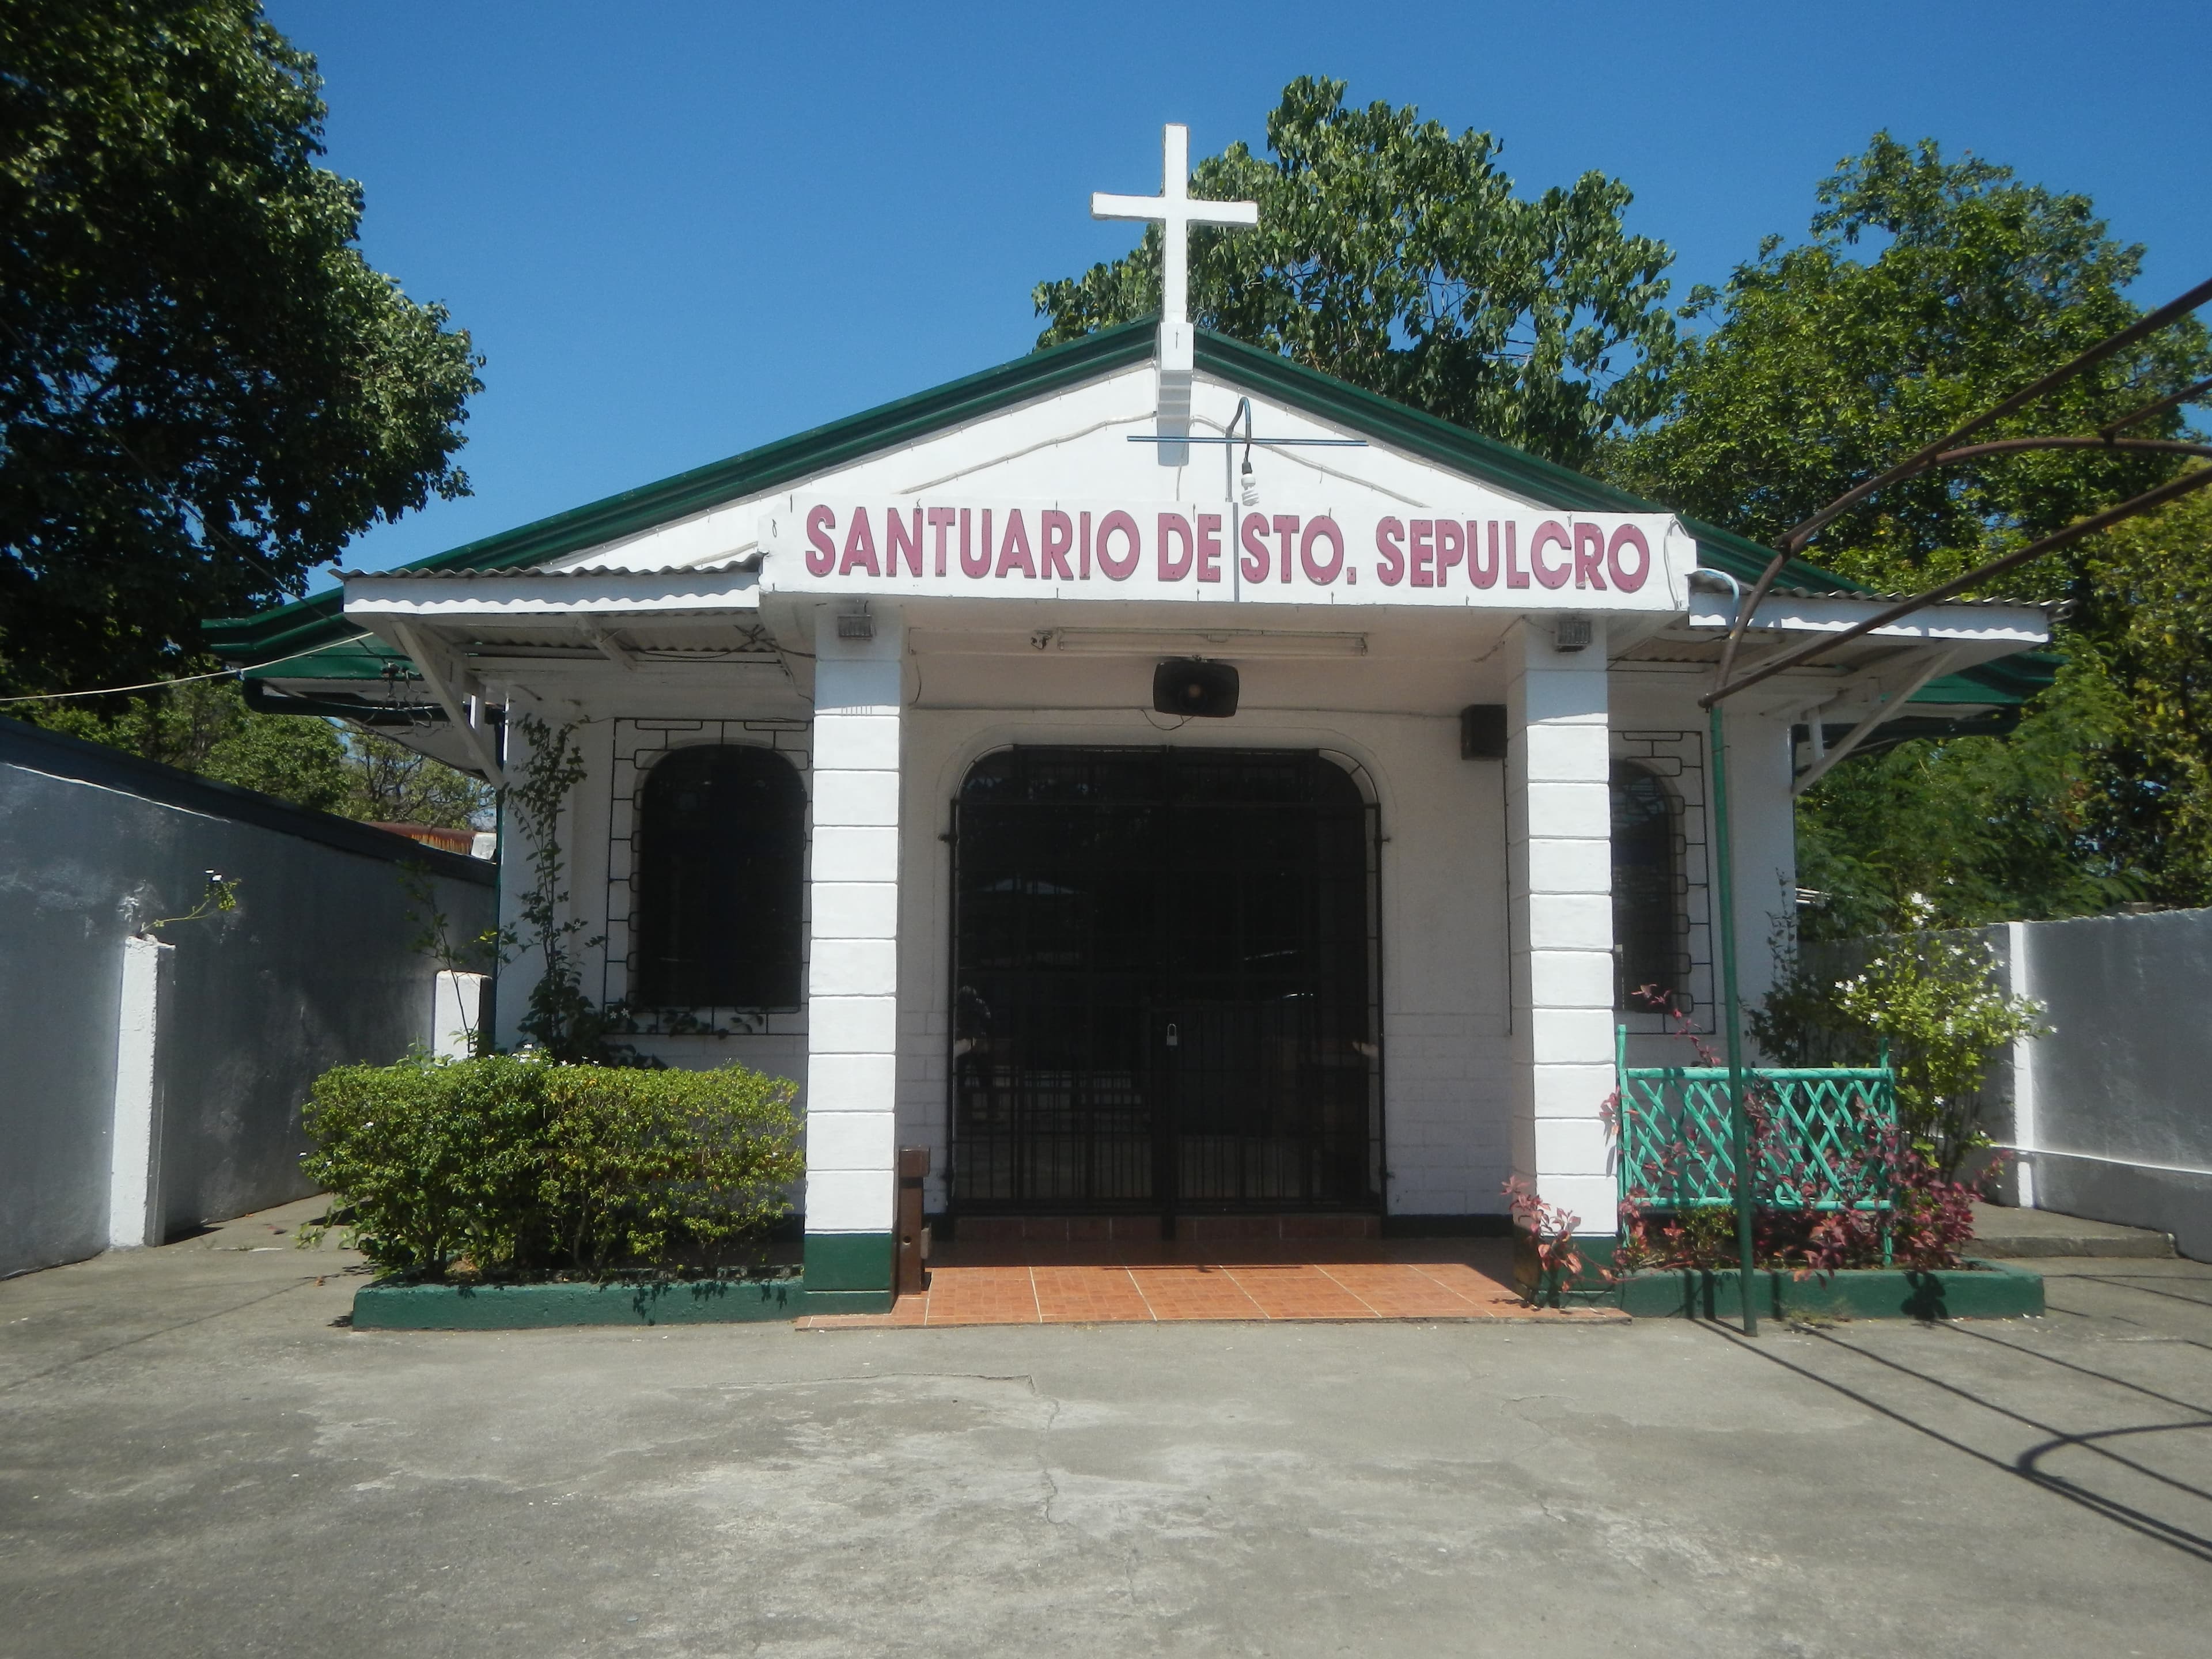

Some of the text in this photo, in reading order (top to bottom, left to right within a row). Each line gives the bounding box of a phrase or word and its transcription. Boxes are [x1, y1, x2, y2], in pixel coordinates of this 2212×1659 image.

[805, 505, 1650, 592] SANTUARIO DE STO. SEPULCRO
